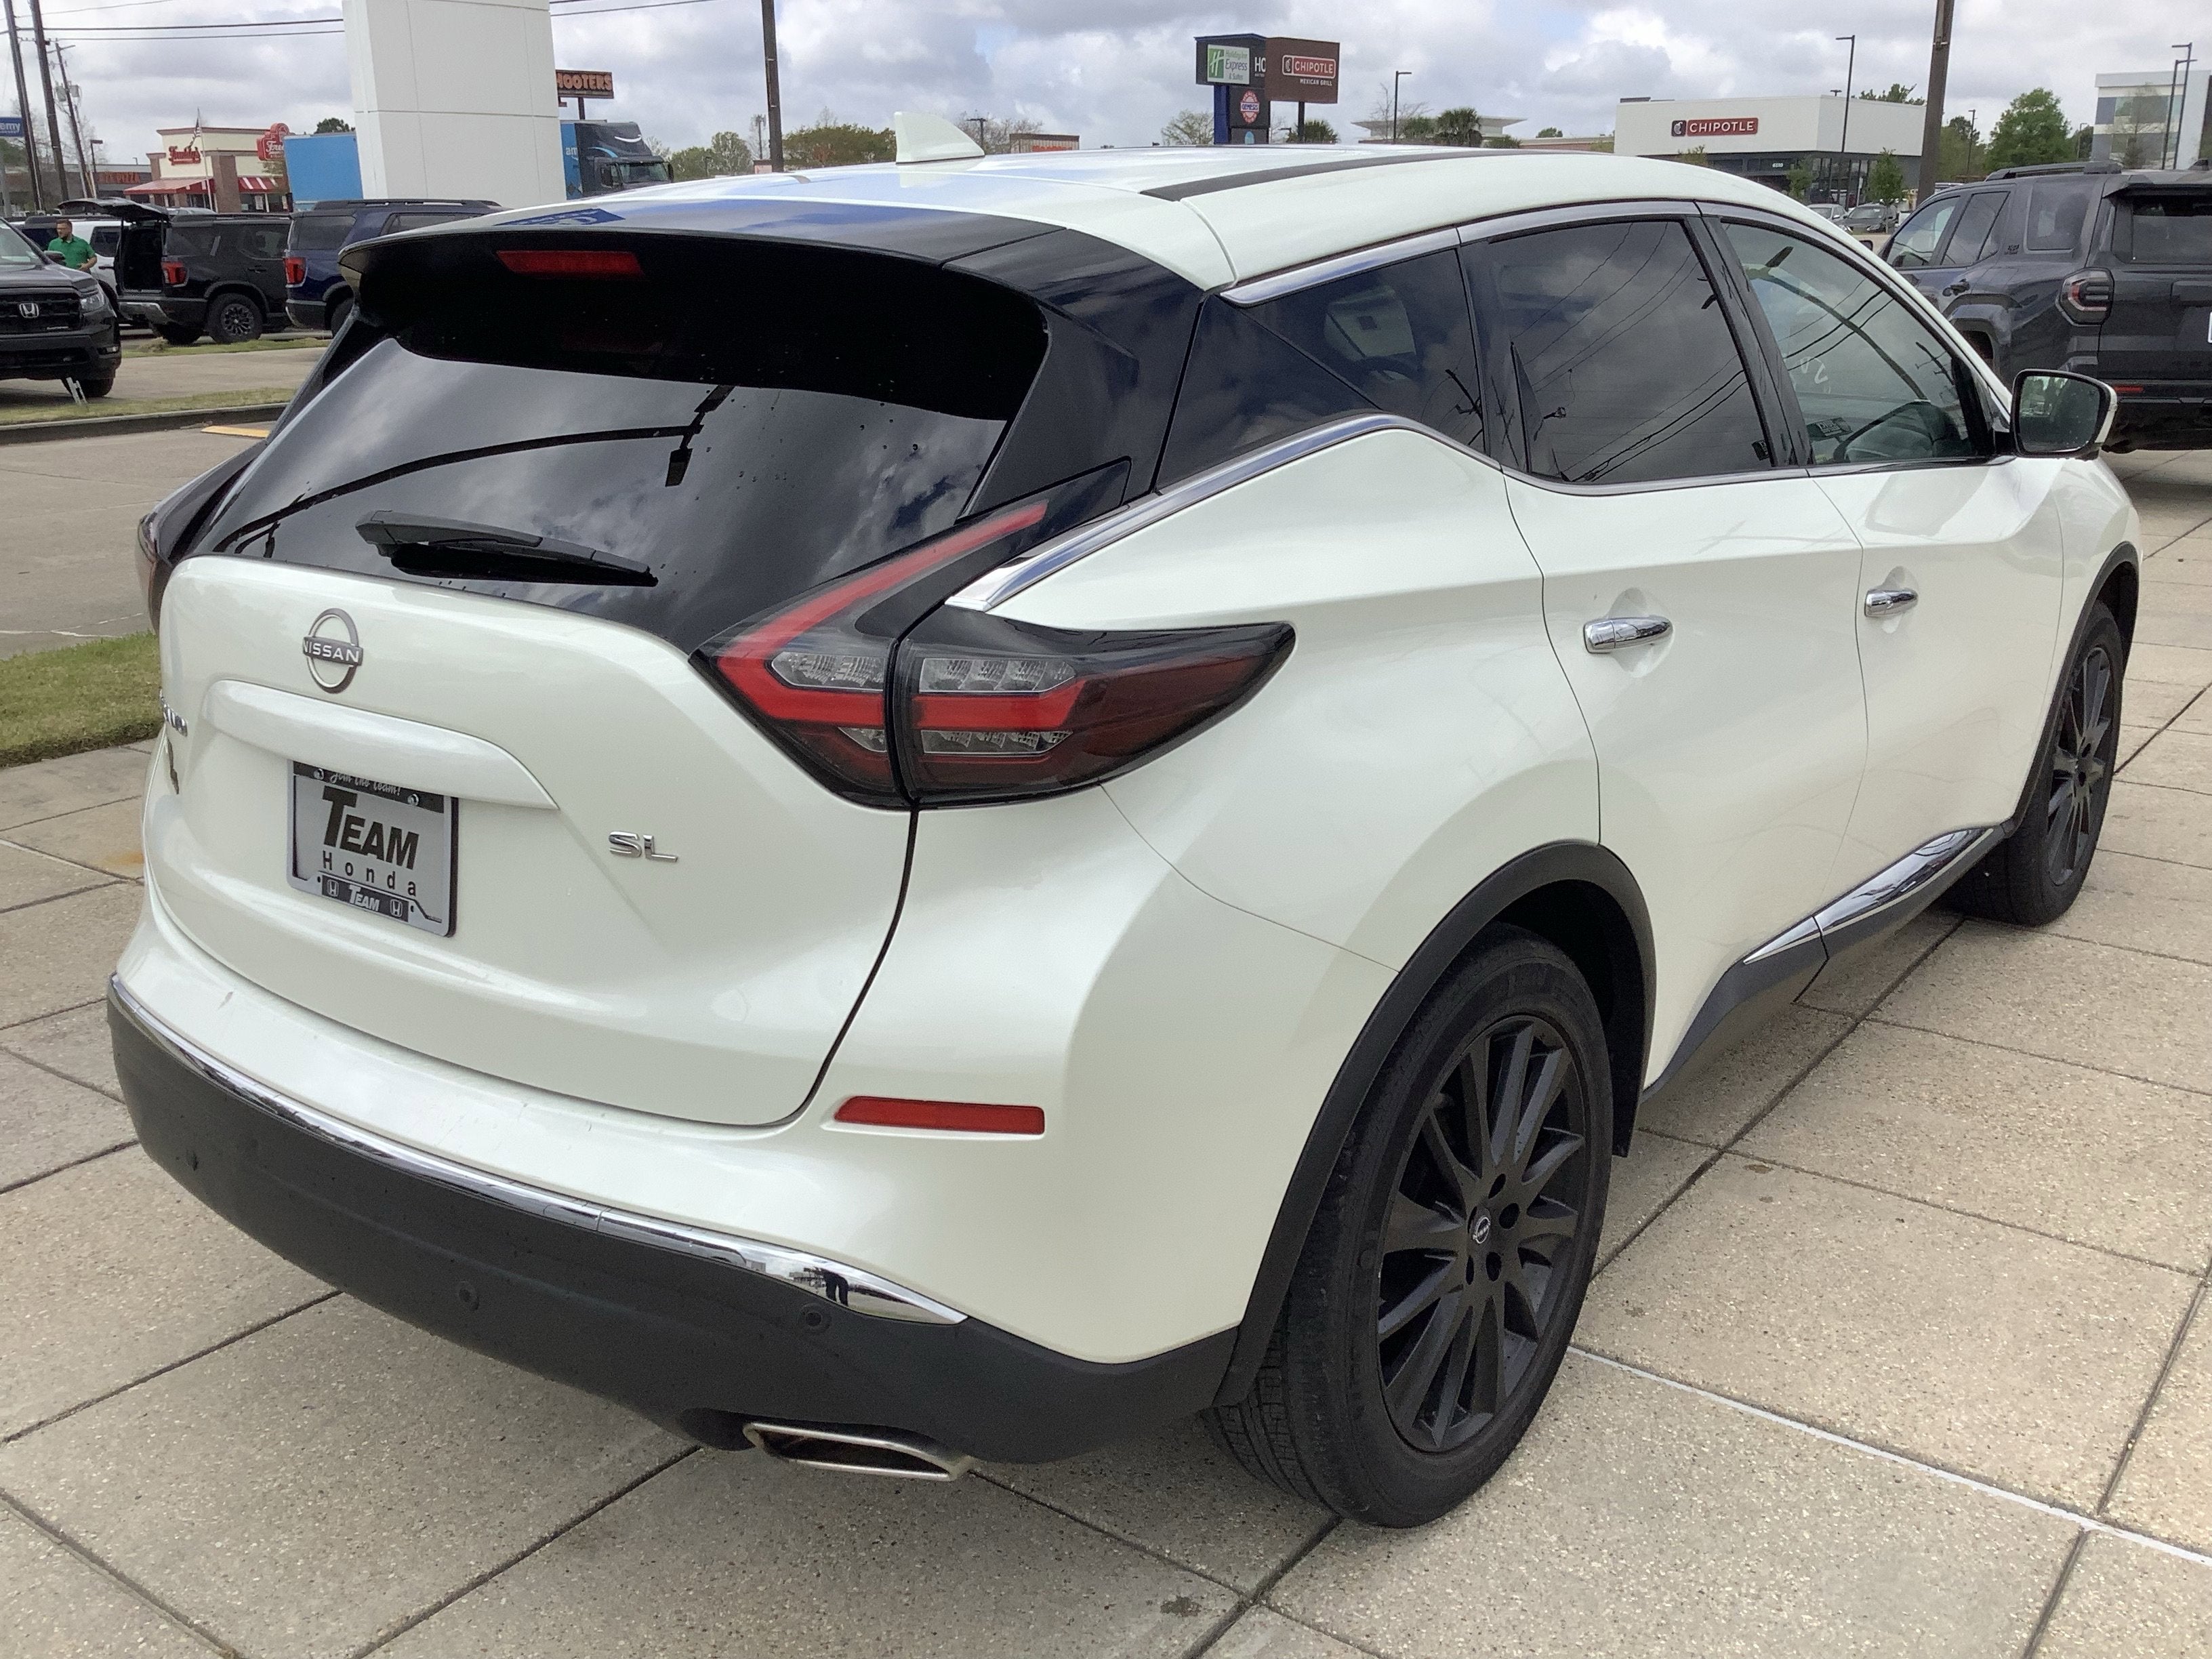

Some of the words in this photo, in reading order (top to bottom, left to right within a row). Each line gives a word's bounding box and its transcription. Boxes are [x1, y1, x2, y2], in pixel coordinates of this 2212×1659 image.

[1225, 58, 1248, 72] Express
[1294, 60, 1334, 74] CHIPOTLE
[1689, 121, 1755, 133] CHIPOTLE
[303, 640, 359, 663] NISSAN
[322, 785, 419, 870] TEAM
[609, 830, 678, 863] SL
[349, 884, 380, 912] TEAM
